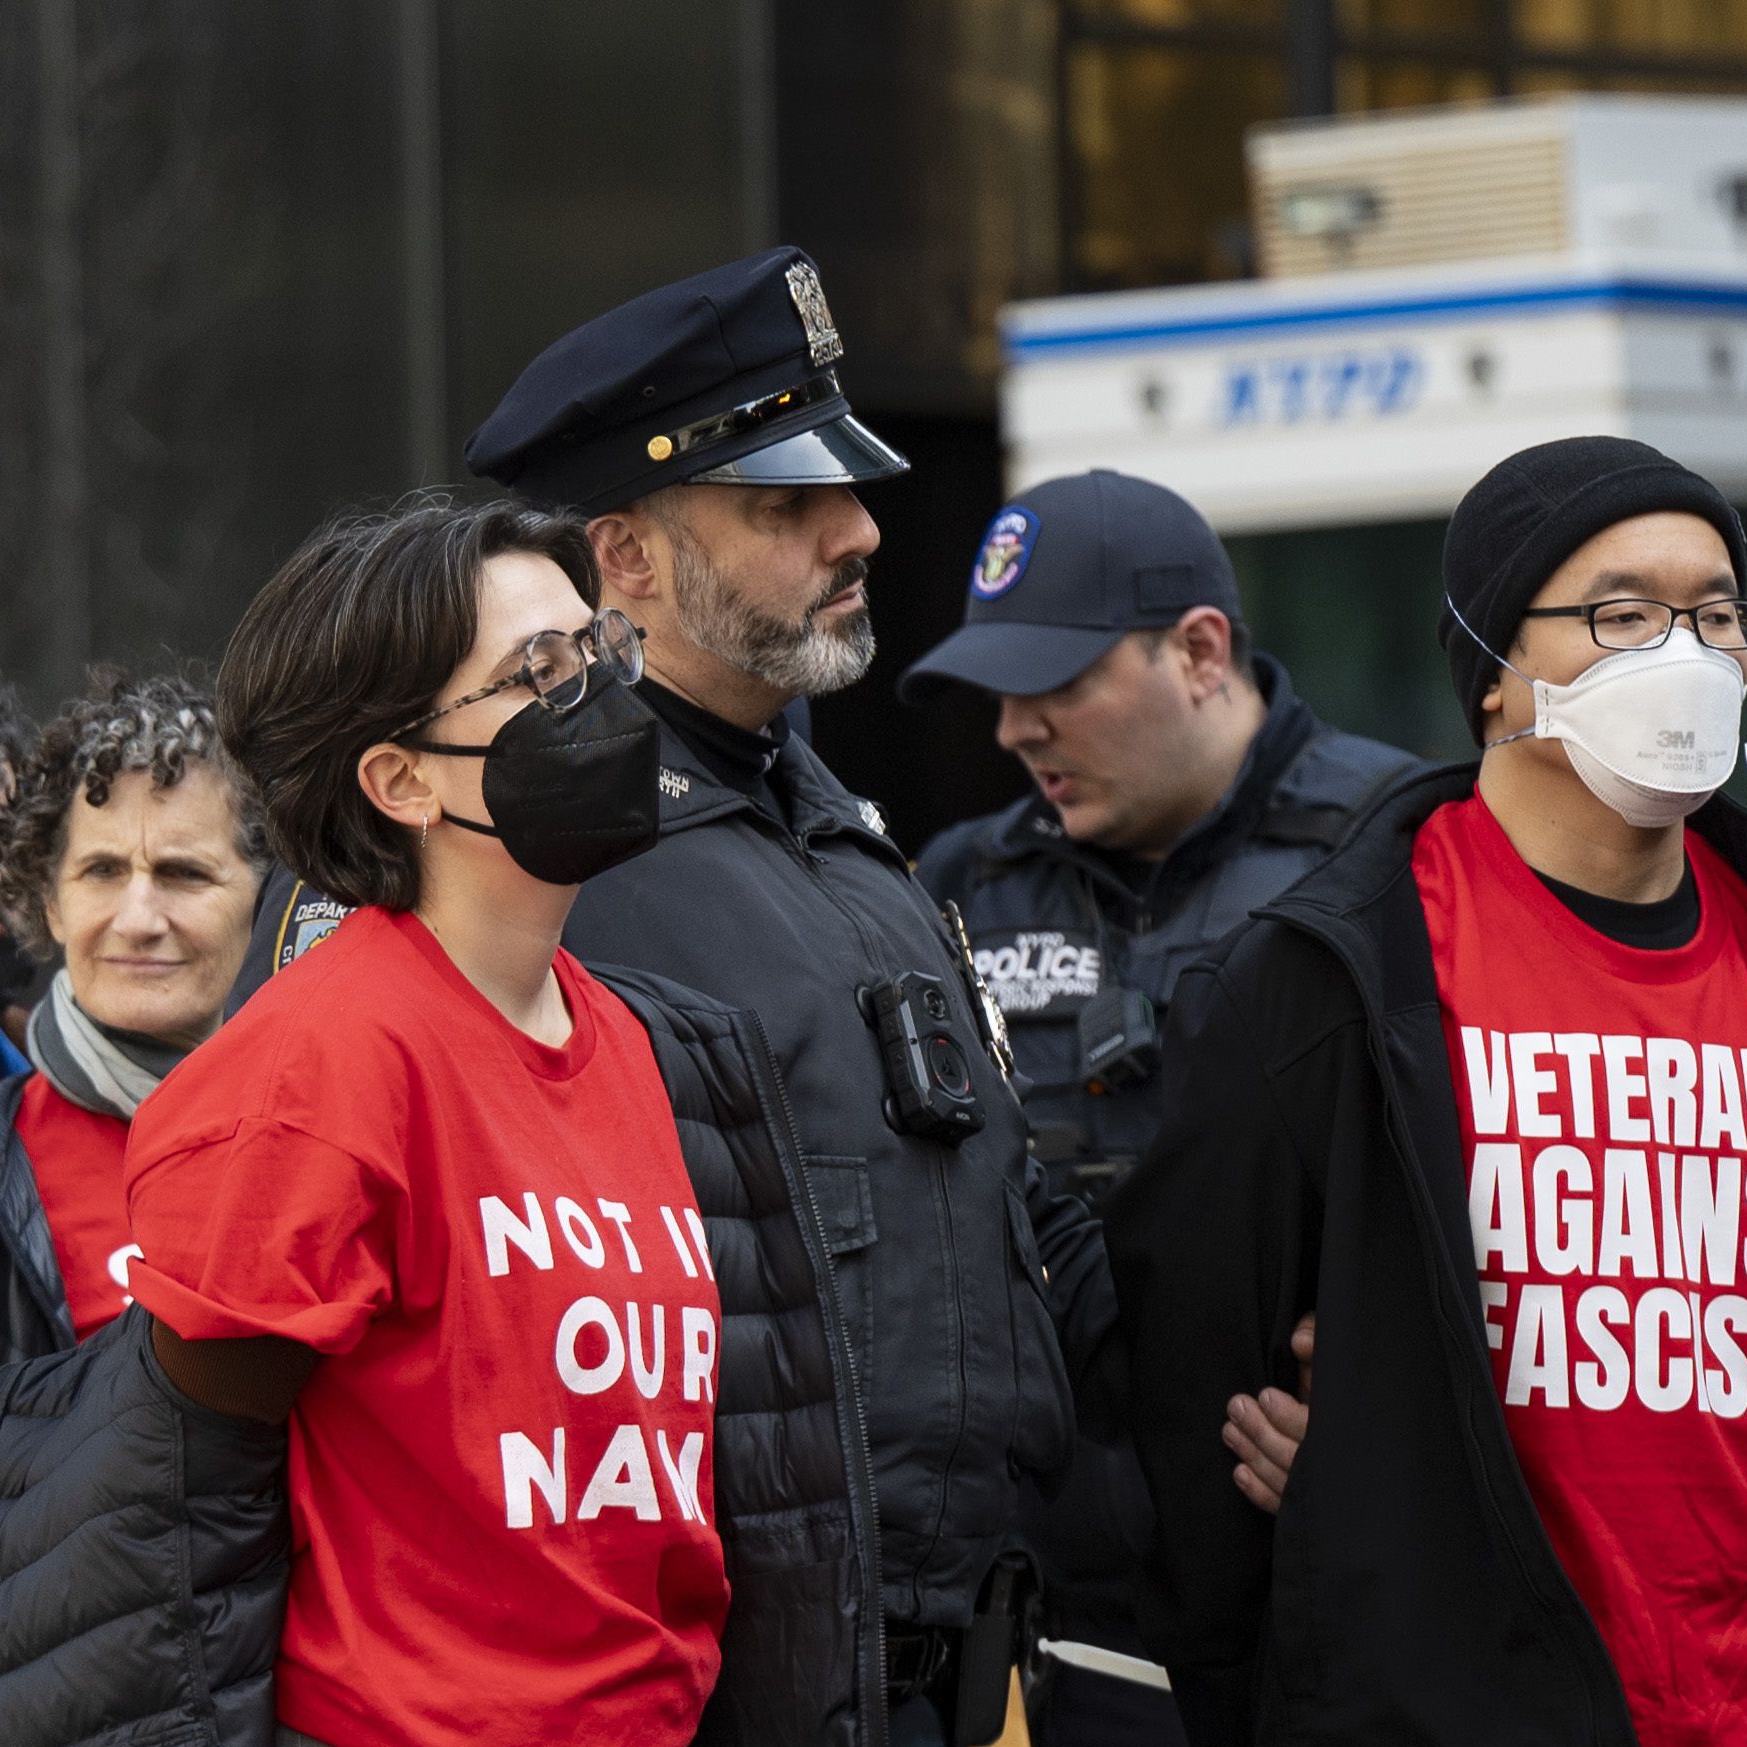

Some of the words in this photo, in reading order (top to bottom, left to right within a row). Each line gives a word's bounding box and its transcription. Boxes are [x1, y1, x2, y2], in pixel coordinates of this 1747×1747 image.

[1655, 730, 1695, 749] 3M
[294, 901, 359, 923] DEPAR
[973, 945, 1101, 980] POLICE
[479, 1192, 643, 1277] NOT
[556, 1296, 716, 1403] OUR
[500, 1424, 707, 1529] NAM
